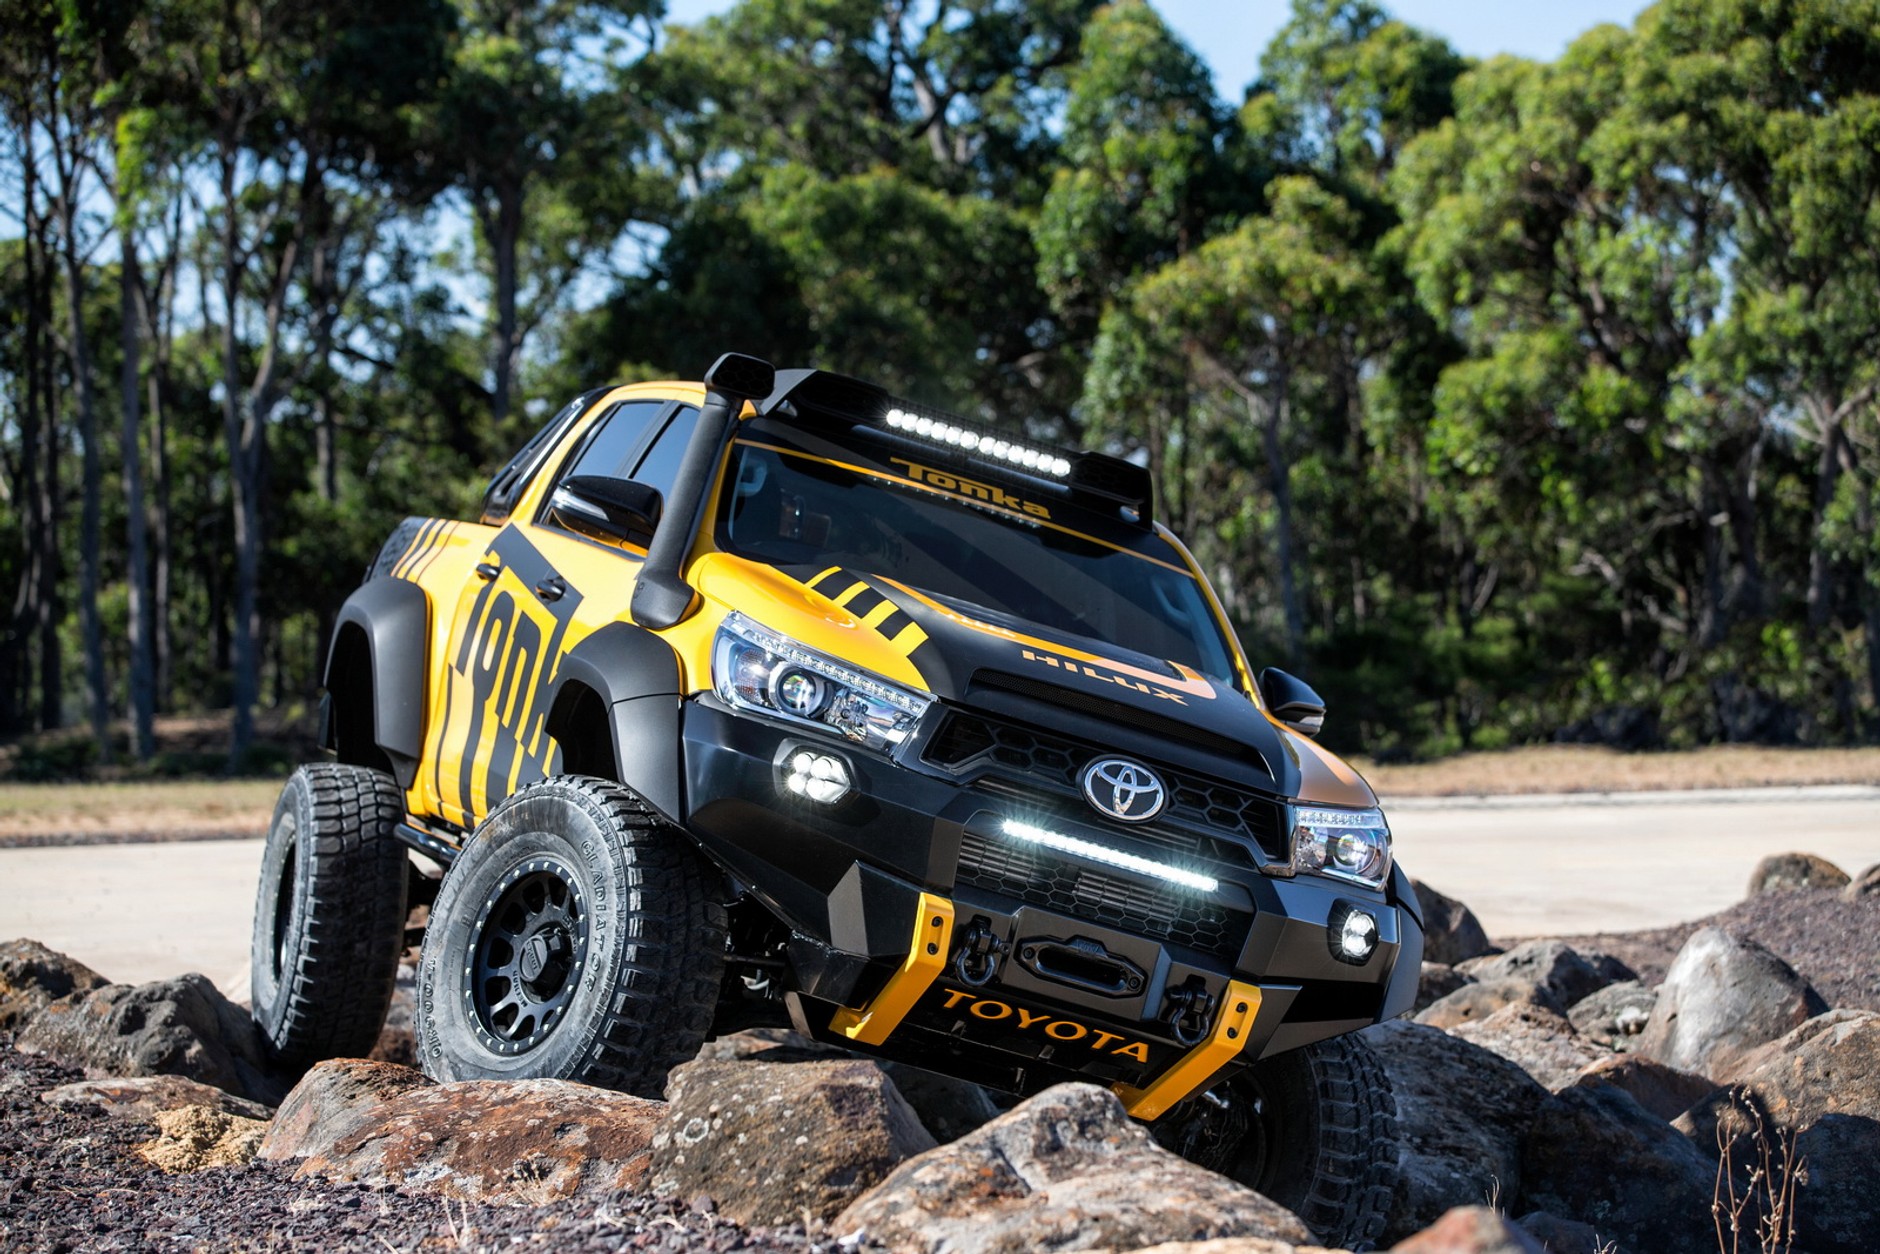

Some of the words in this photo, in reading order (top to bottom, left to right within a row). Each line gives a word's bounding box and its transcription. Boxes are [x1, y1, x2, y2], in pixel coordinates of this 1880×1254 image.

[889, 457, 1052, 519] Tonka
[1022, 650, 1189, 706] HILUX
[581, 840, 608, 992] GLADIATOR
[943, 988, 1150, 1063] TOYOTA
